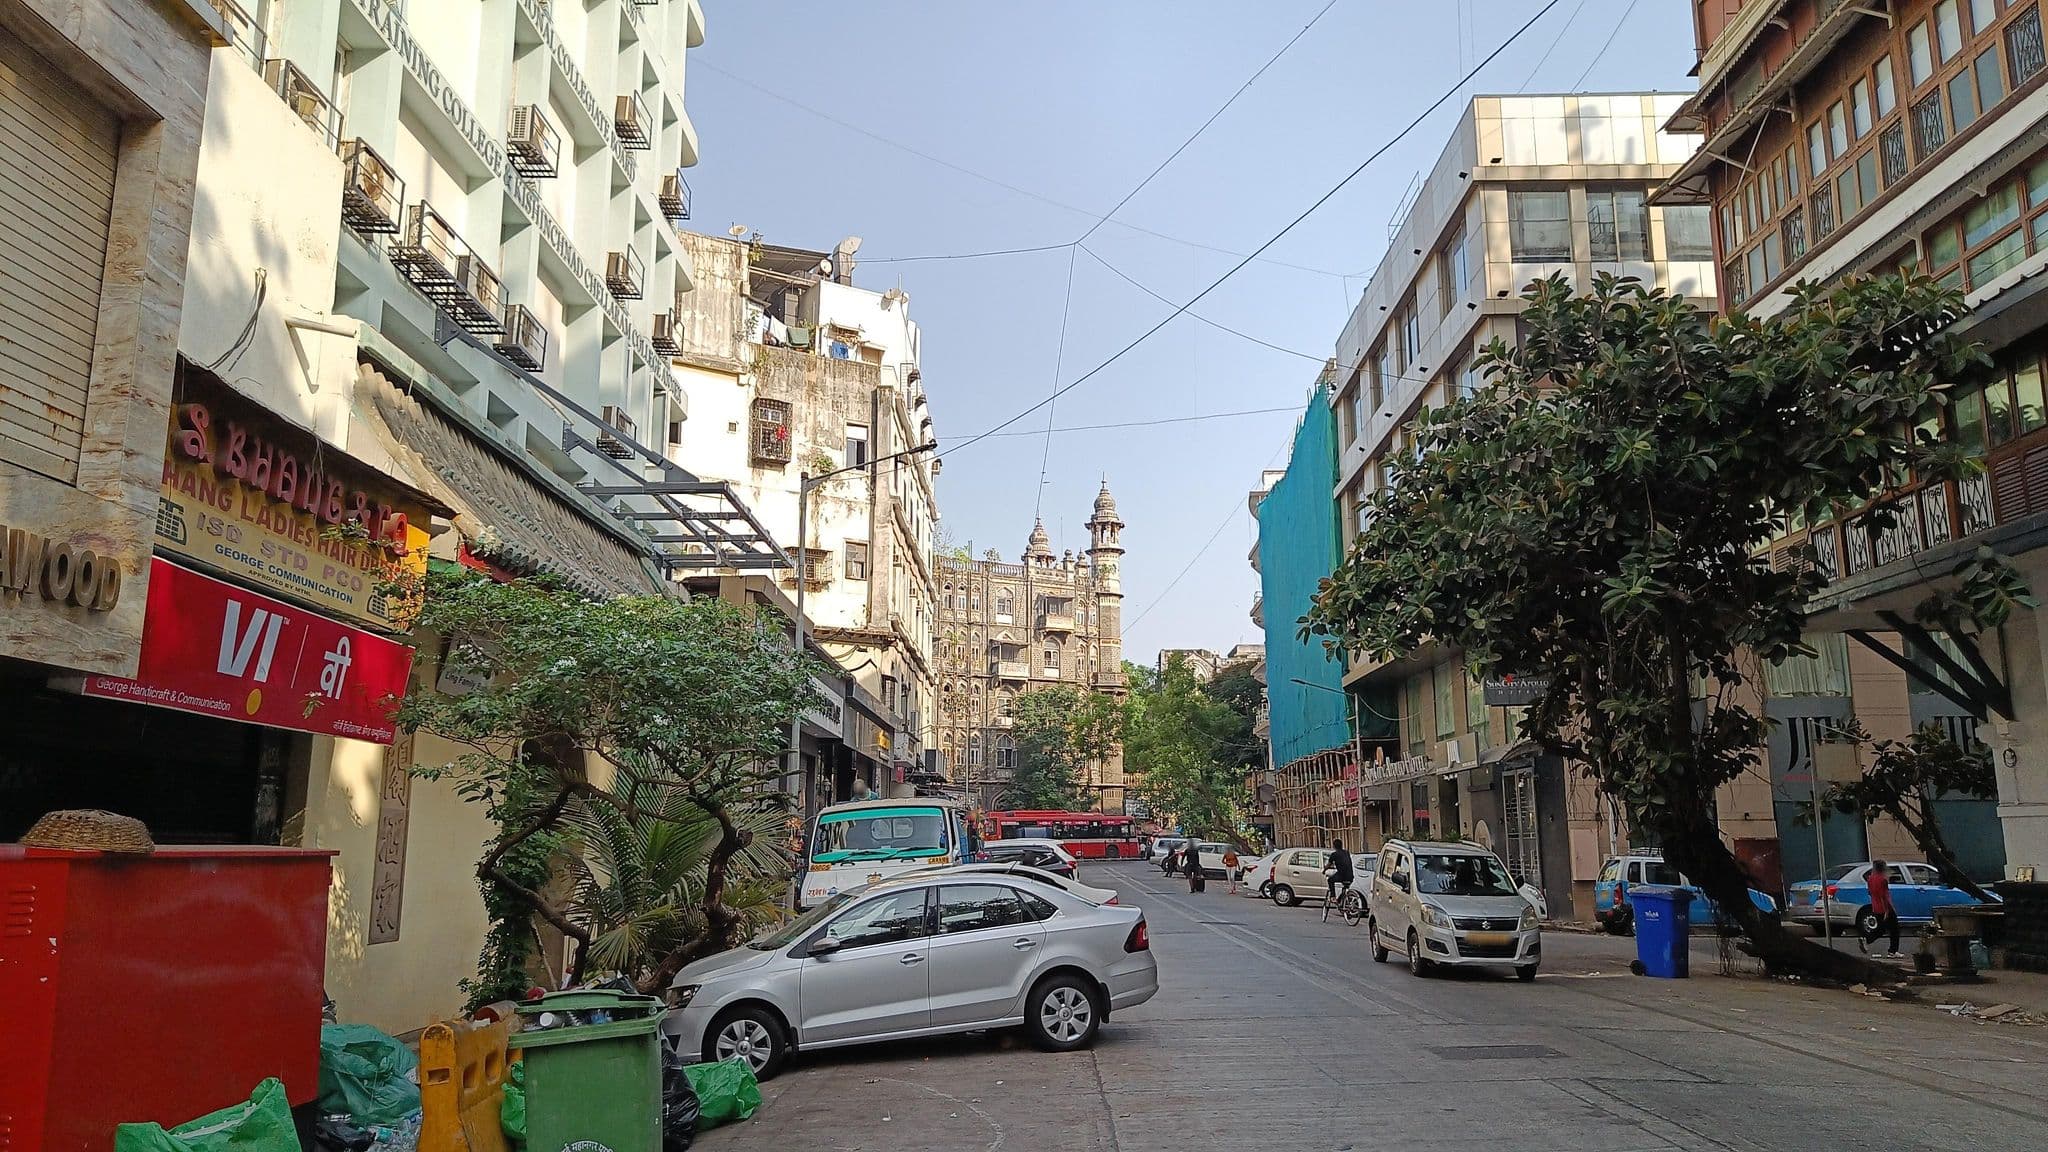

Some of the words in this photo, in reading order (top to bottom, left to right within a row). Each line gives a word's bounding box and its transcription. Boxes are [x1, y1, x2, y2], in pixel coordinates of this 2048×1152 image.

[442, 86, 502, 178] COLLEGE
[503, 163, 514, 190] &
[197, 511, 242, 544] ISD
[261, 540, 308, 571] STD
[323, 564, 363, 592] PCO
[241, 495, 313, 546] LADIES
[317, 538, 356, 567] HAIR
[215, 543, 264, 570] GEORGE
[268, 564, 353, 604] COMMUNICATION
[248, 569, 283, 586] APPROVED
[295, 586, 312, 597] MTNL
[96, 677, 129, 695] George
[129, 682, 170, 700] Handicraft
[170, 690, 177, 701] &
[177, 691, 231, 711] Communication
[320, 635, 352, 700] वी
